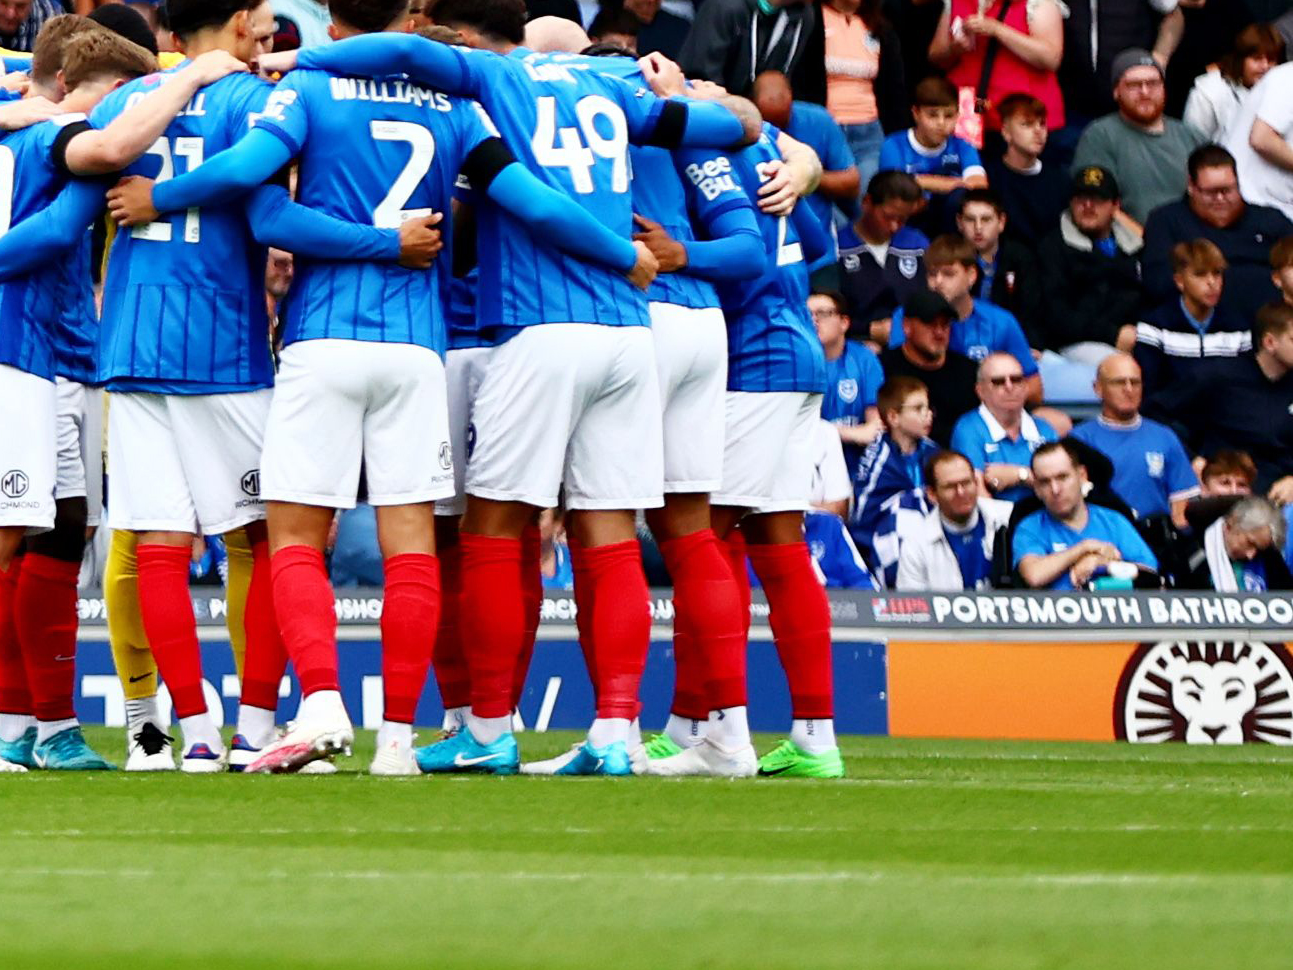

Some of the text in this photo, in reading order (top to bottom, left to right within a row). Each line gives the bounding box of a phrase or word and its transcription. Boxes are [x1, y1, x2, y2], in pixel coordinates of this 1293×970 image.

[330, 77, 452, 112] WILLIAMS
[532, 94, 629, 194] 49
[369, 119, 435, 229] 2
[685, 156, 732, 186] Bee
[3, 472, 27, 496] MG
[932, 596, 1142, 624] PORTSMOUTH
[1148, 597, 1293, 626] BATHROO
